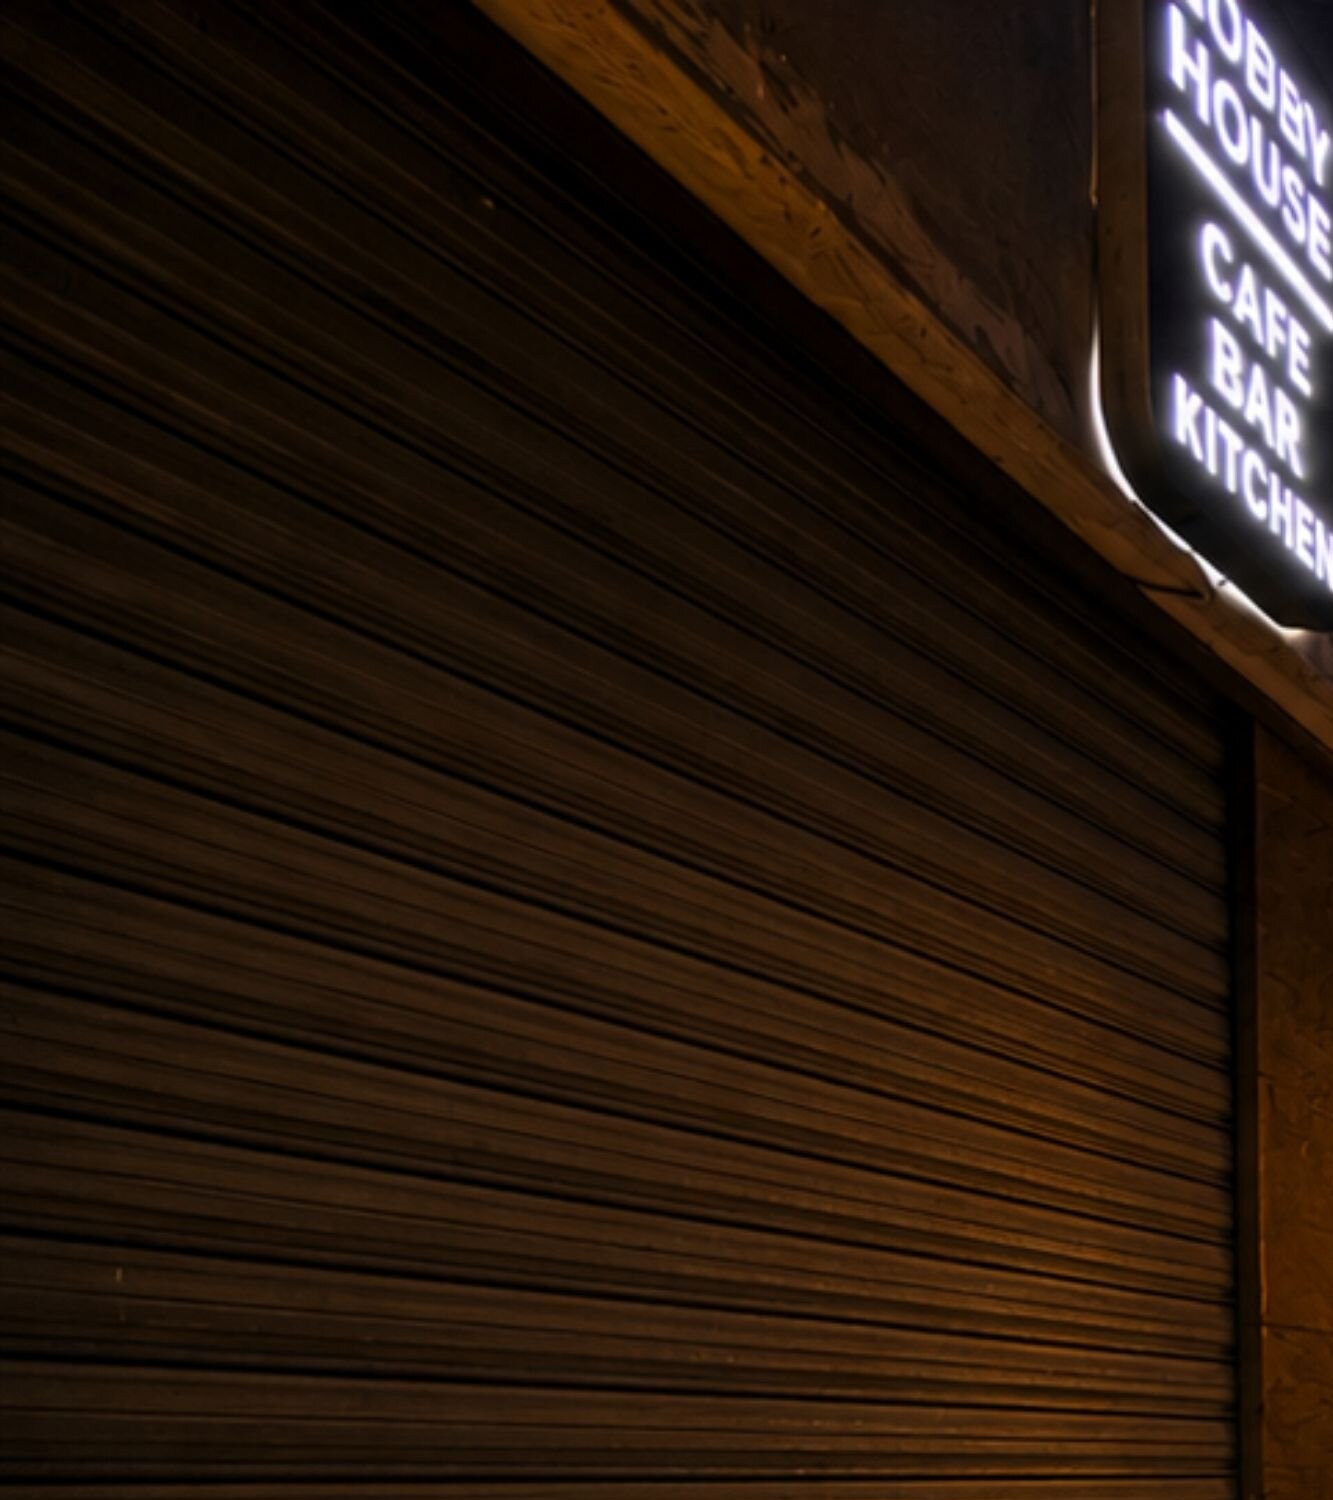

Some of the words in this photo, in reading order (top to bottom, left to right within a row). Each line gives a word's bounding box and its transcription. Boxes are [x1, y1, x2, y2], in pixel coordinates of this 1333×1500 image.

[1165, 2, 1333, 283] HOUSE
[1182, 0, 1332, 187] OBBY
[1199, 221, 1312, 398] CAFE
[1209, 316, 1305, 480] BAR
